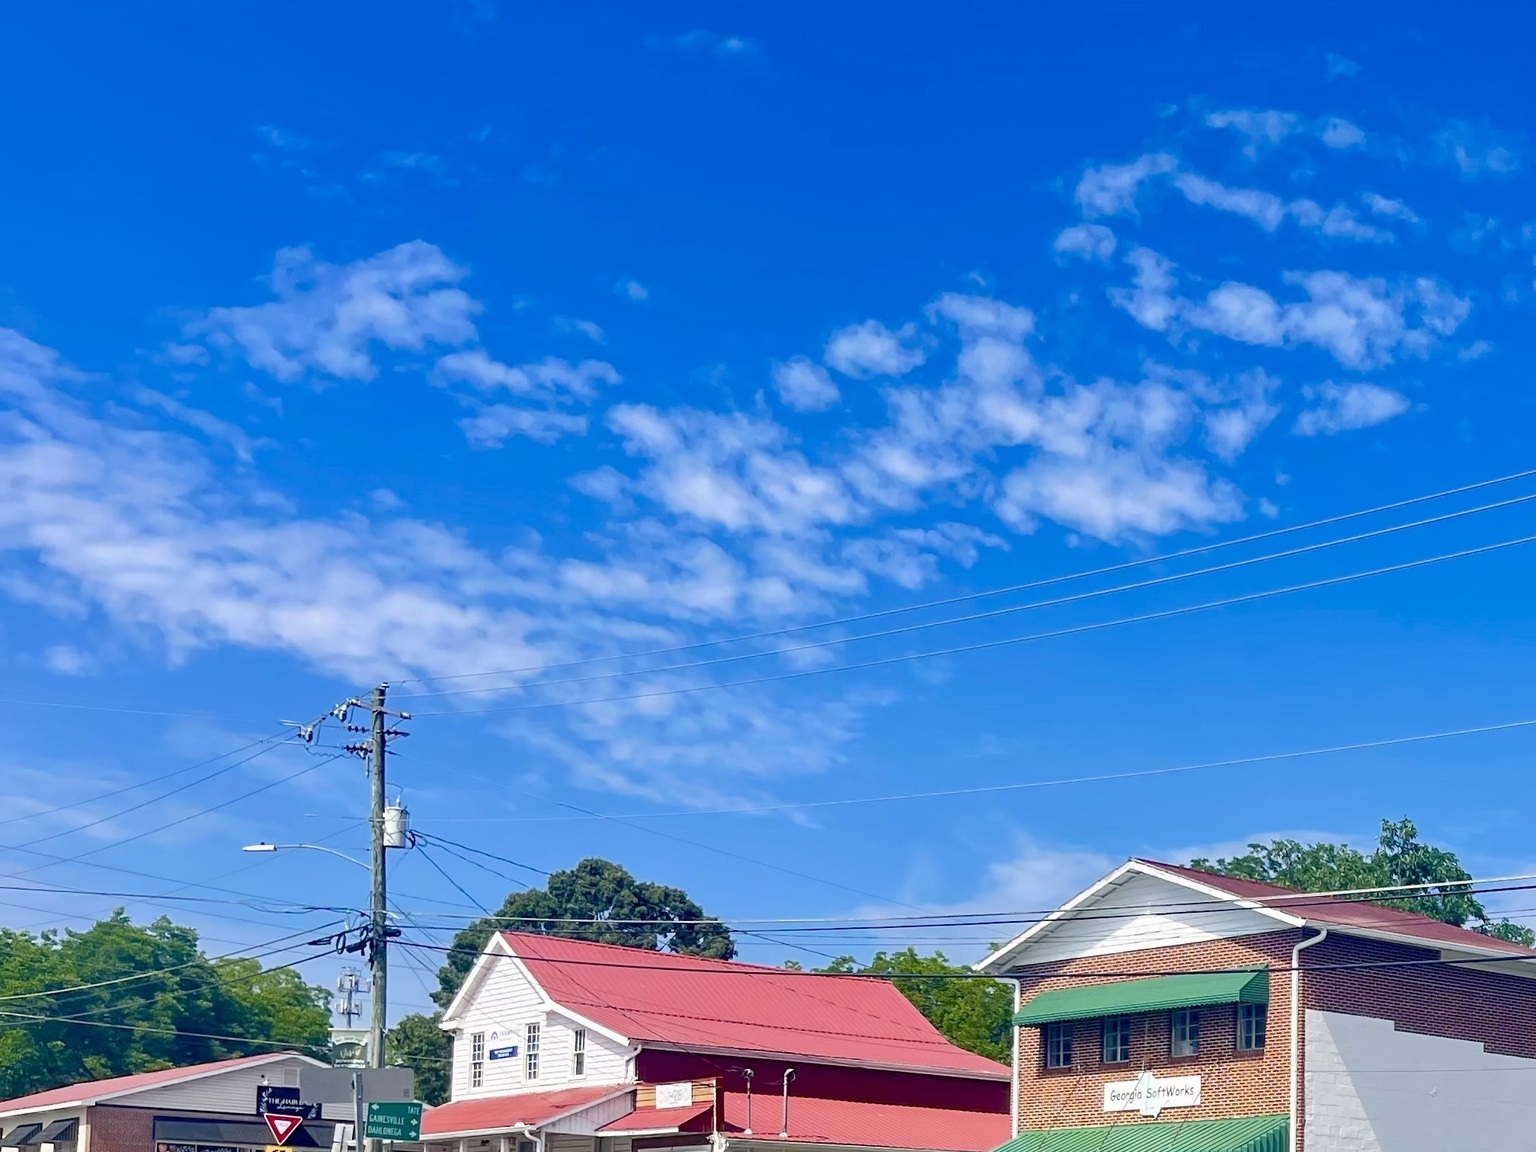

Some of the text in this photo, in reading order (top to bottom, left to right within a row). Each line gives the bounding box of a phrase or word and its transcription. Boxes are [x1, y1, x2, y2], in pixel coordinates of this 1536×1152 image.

[1110, 1084, 1194, 1104] Georgia SoftWorks
[407, 1105, 420, 1115] TATE
[369, 1113, 405, 1125] GAINESVILLE
[367, 1125, 402, 1136] DAHLONEGA
